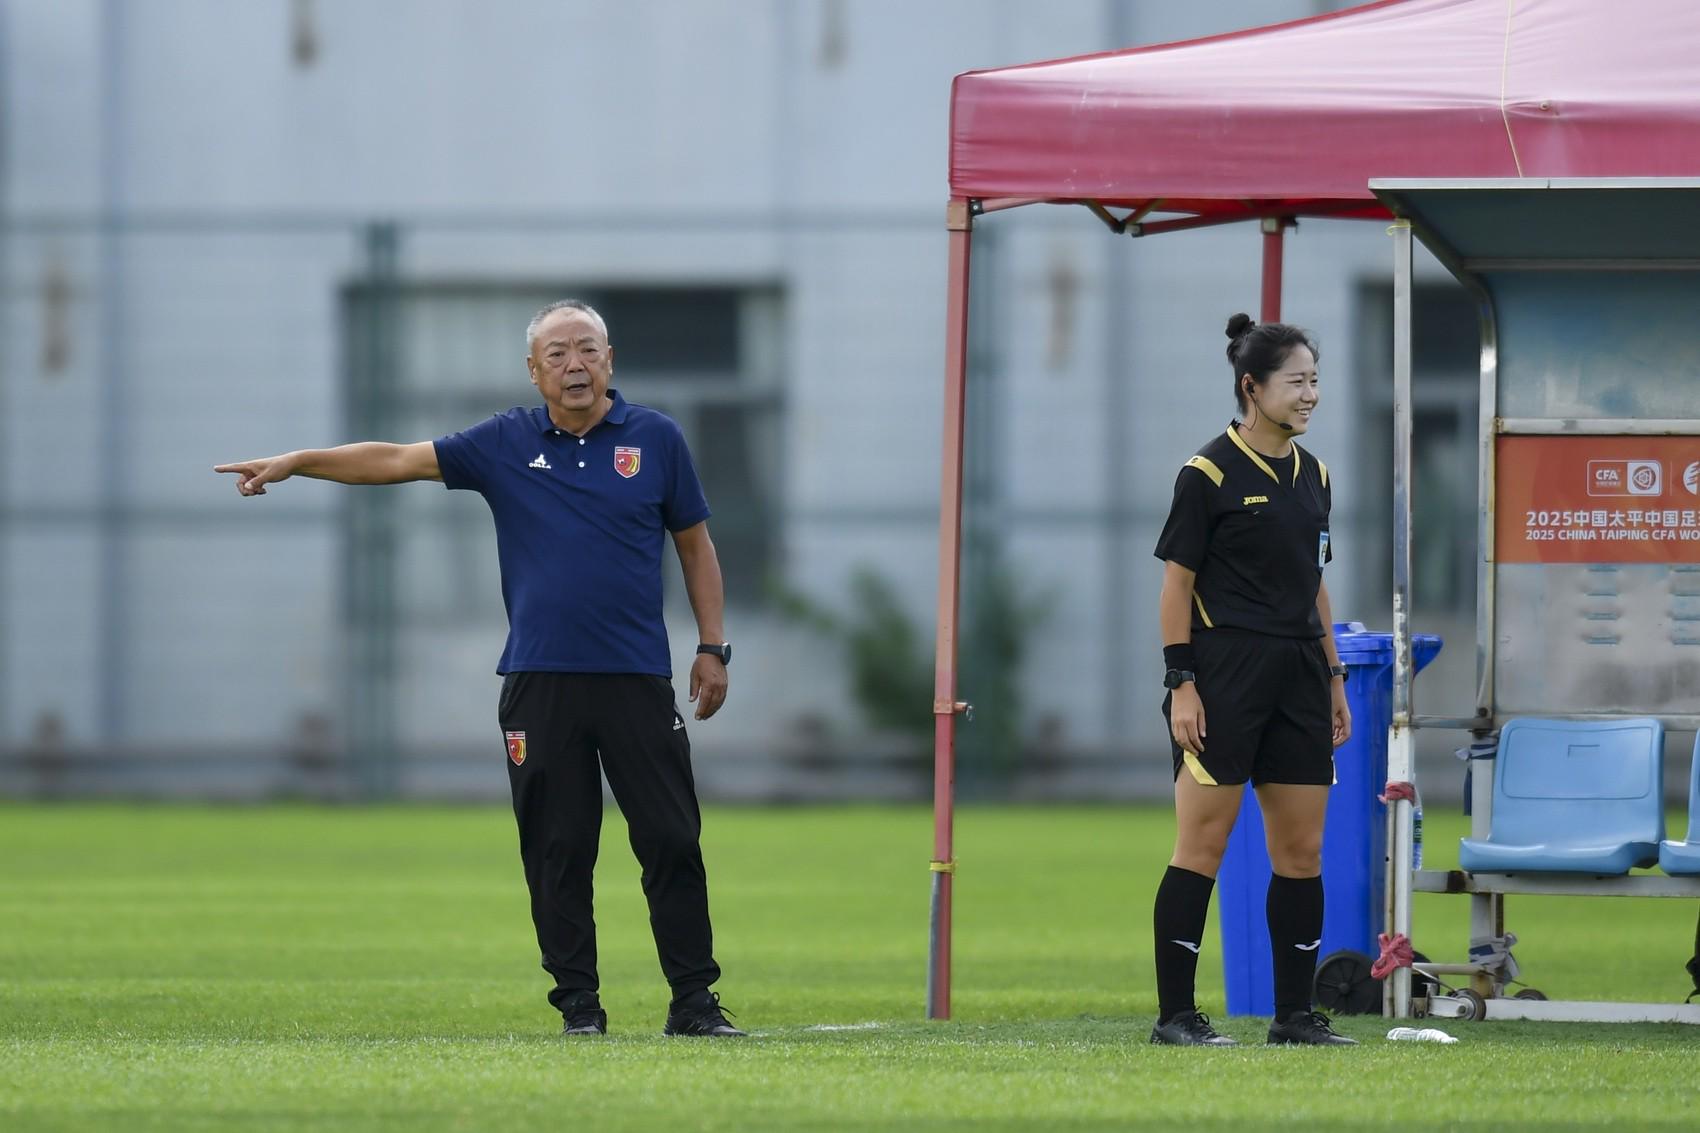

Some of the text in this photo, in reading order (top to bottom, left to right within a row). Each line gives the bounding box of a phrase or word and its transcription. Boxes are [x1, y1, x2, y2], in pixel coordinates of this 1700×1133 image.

[1595, 469, 1618, 480] CFA
[1526, 510, 1700, 527] 2025中国太平中国足
[1526, 529, 1554, 541] 2025
[1558, 529, 1596, 541] CHINA
[1599, 529, 1649, 541] TAIPING
[1652, 529, 1676, 541] CFA
